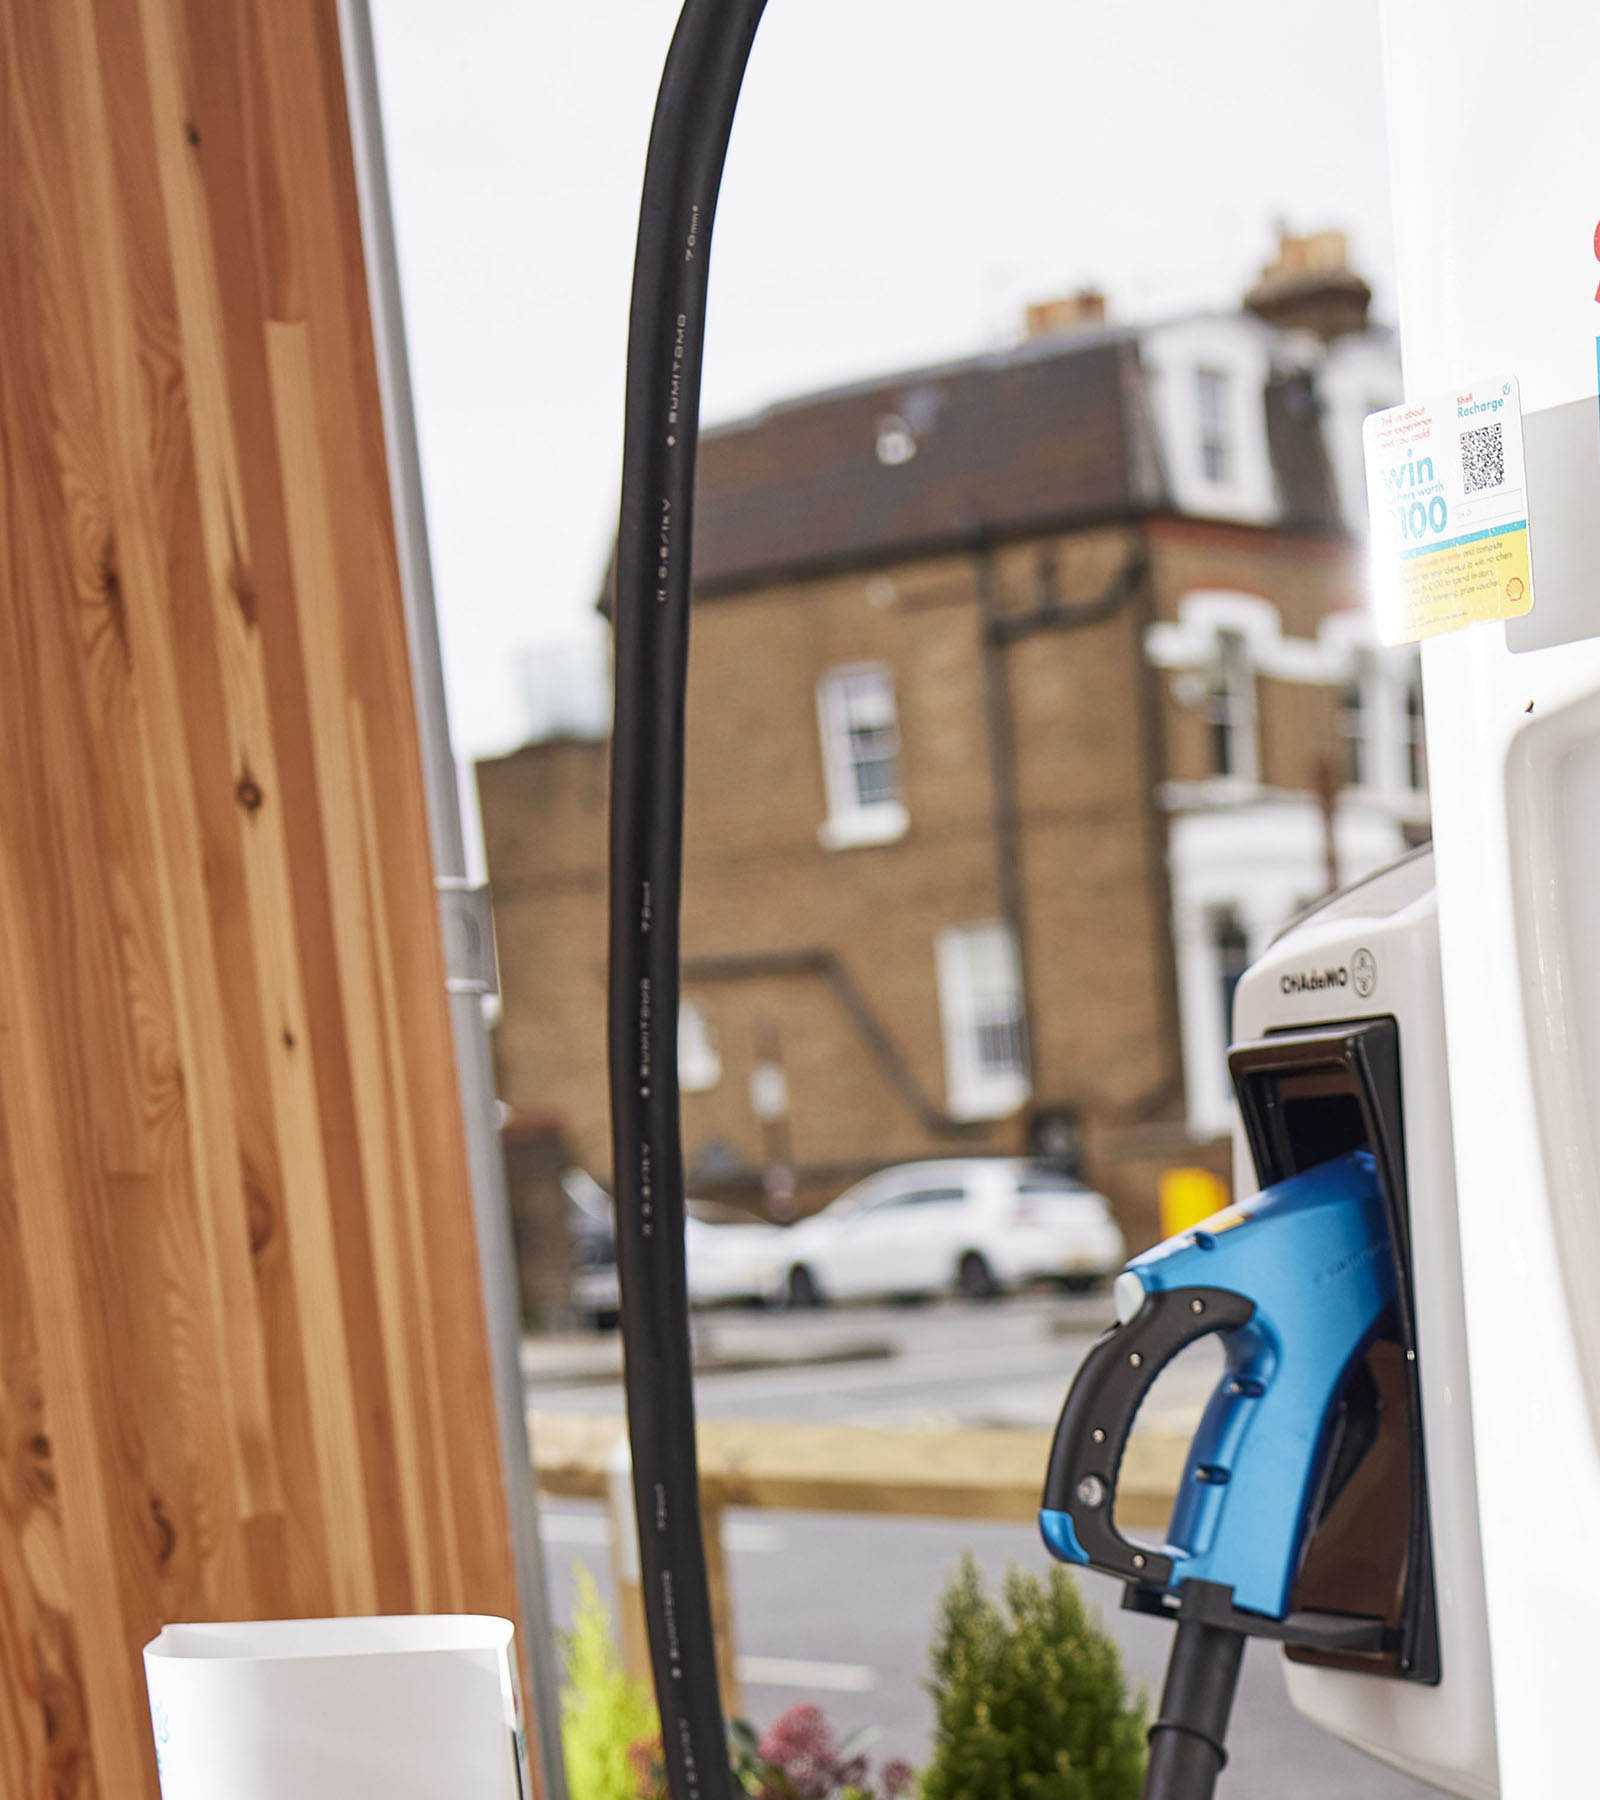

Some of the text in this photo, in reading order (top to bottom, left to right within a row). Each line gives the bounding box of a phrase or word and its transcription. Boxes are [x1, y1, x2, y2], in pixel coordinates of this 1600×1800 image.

[668, 314, 686, 423] SUMITOMO
[1457, 398, 1504, 418] Recharge
[1392, 496, 1447, 540] 100
